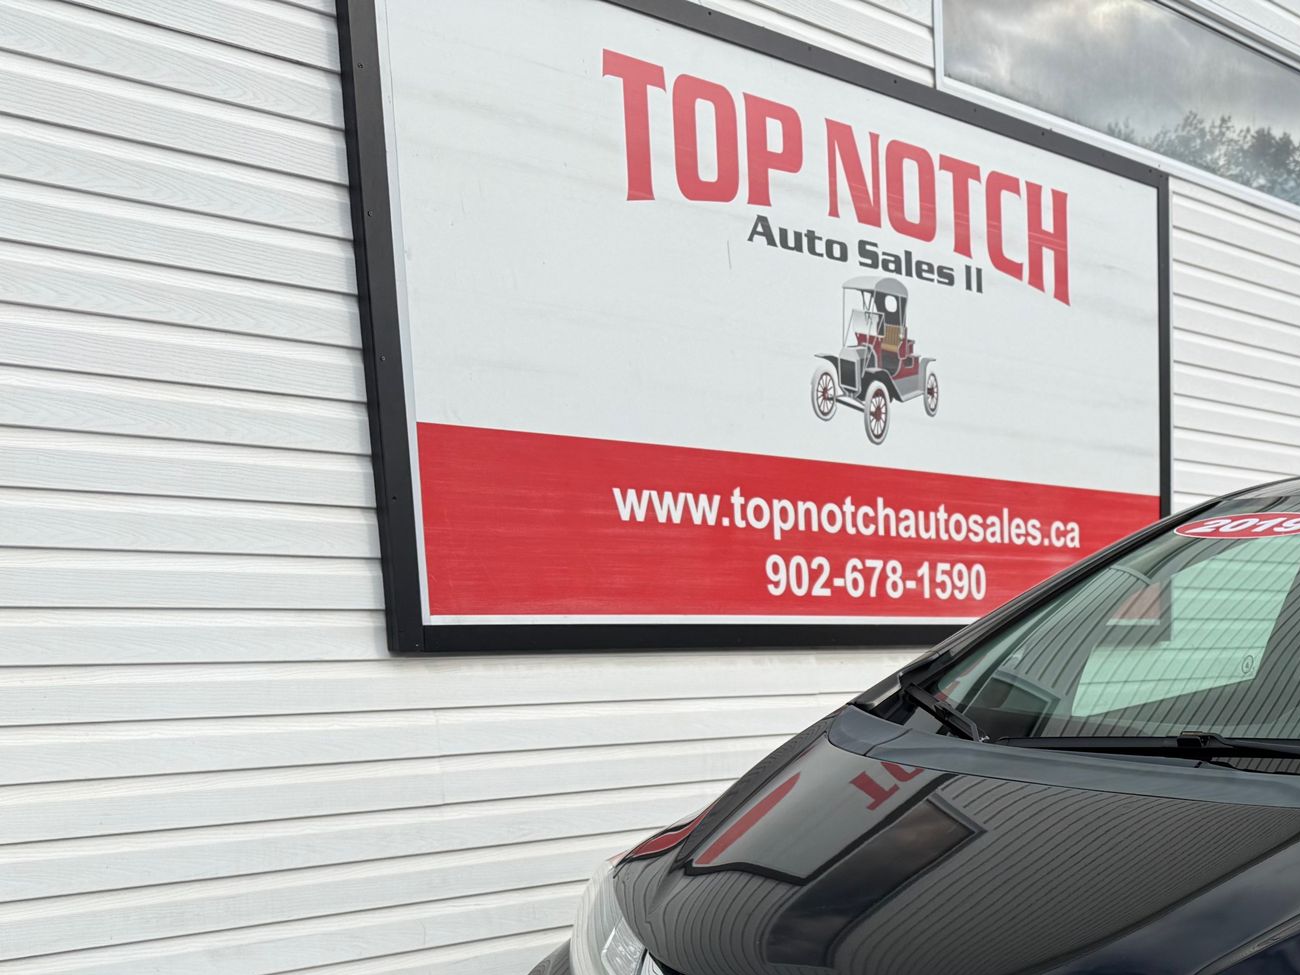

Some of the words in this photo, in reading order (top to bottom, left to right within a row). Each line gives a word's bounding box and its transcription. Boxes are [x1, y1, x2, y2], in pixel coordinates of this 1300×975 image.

[603, 48, 803, 207] TOP
[824, 117, 1071, 306] NOTCH
[747, 214, 848, 263] Auto
[857, 239, 955, 287] Sales
[964, 264, 983, 294] II
[612, 487, 1081, 549] www.topnotchautosales.ca
[765, 554, 987, 601] 902-678-1590
